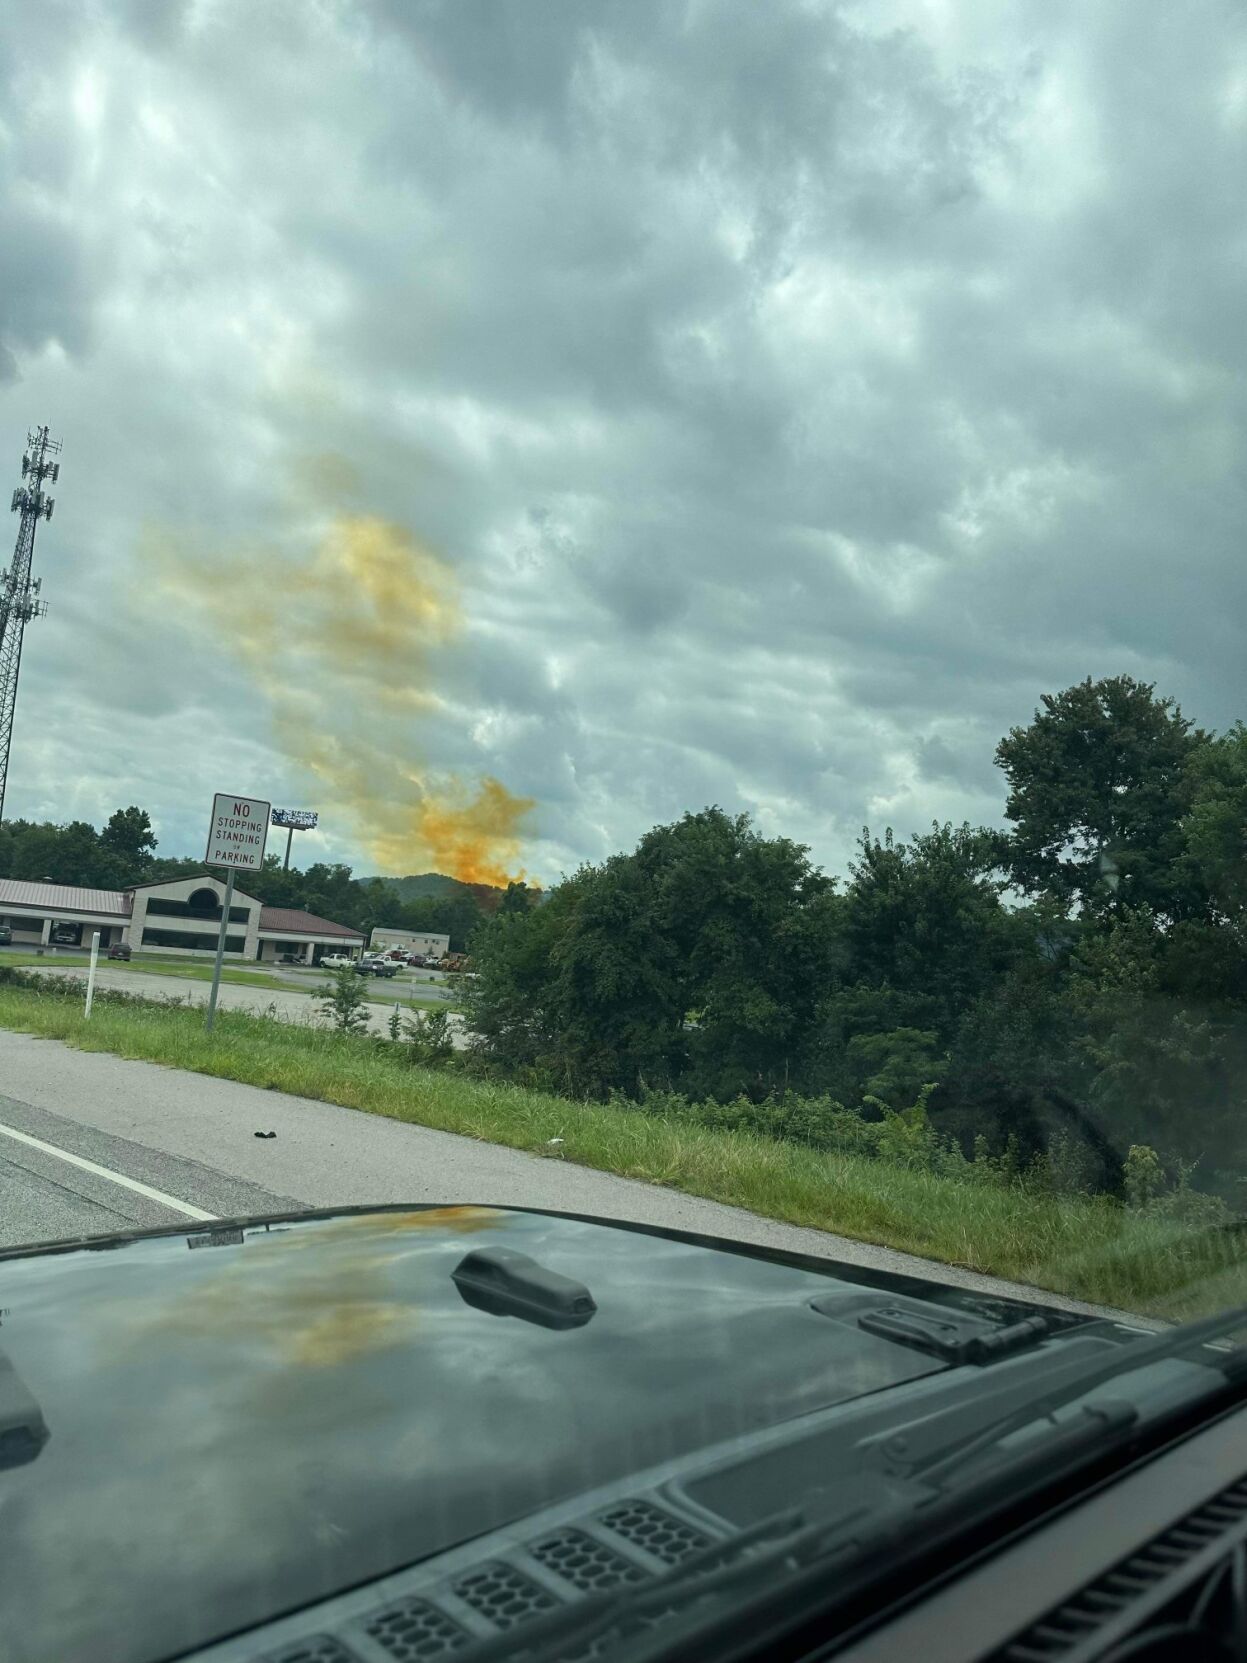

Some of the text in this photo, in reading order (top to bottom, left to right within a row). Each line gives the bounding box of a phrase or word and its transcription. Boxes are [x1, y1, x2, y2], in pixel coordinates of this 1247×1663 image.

[234, 803, 250, 817] NO
[218, 817, 262, 832] STOPPING
[216, 830, 259, 844] STANDING
[215, 850, 254, 864] PARKING
